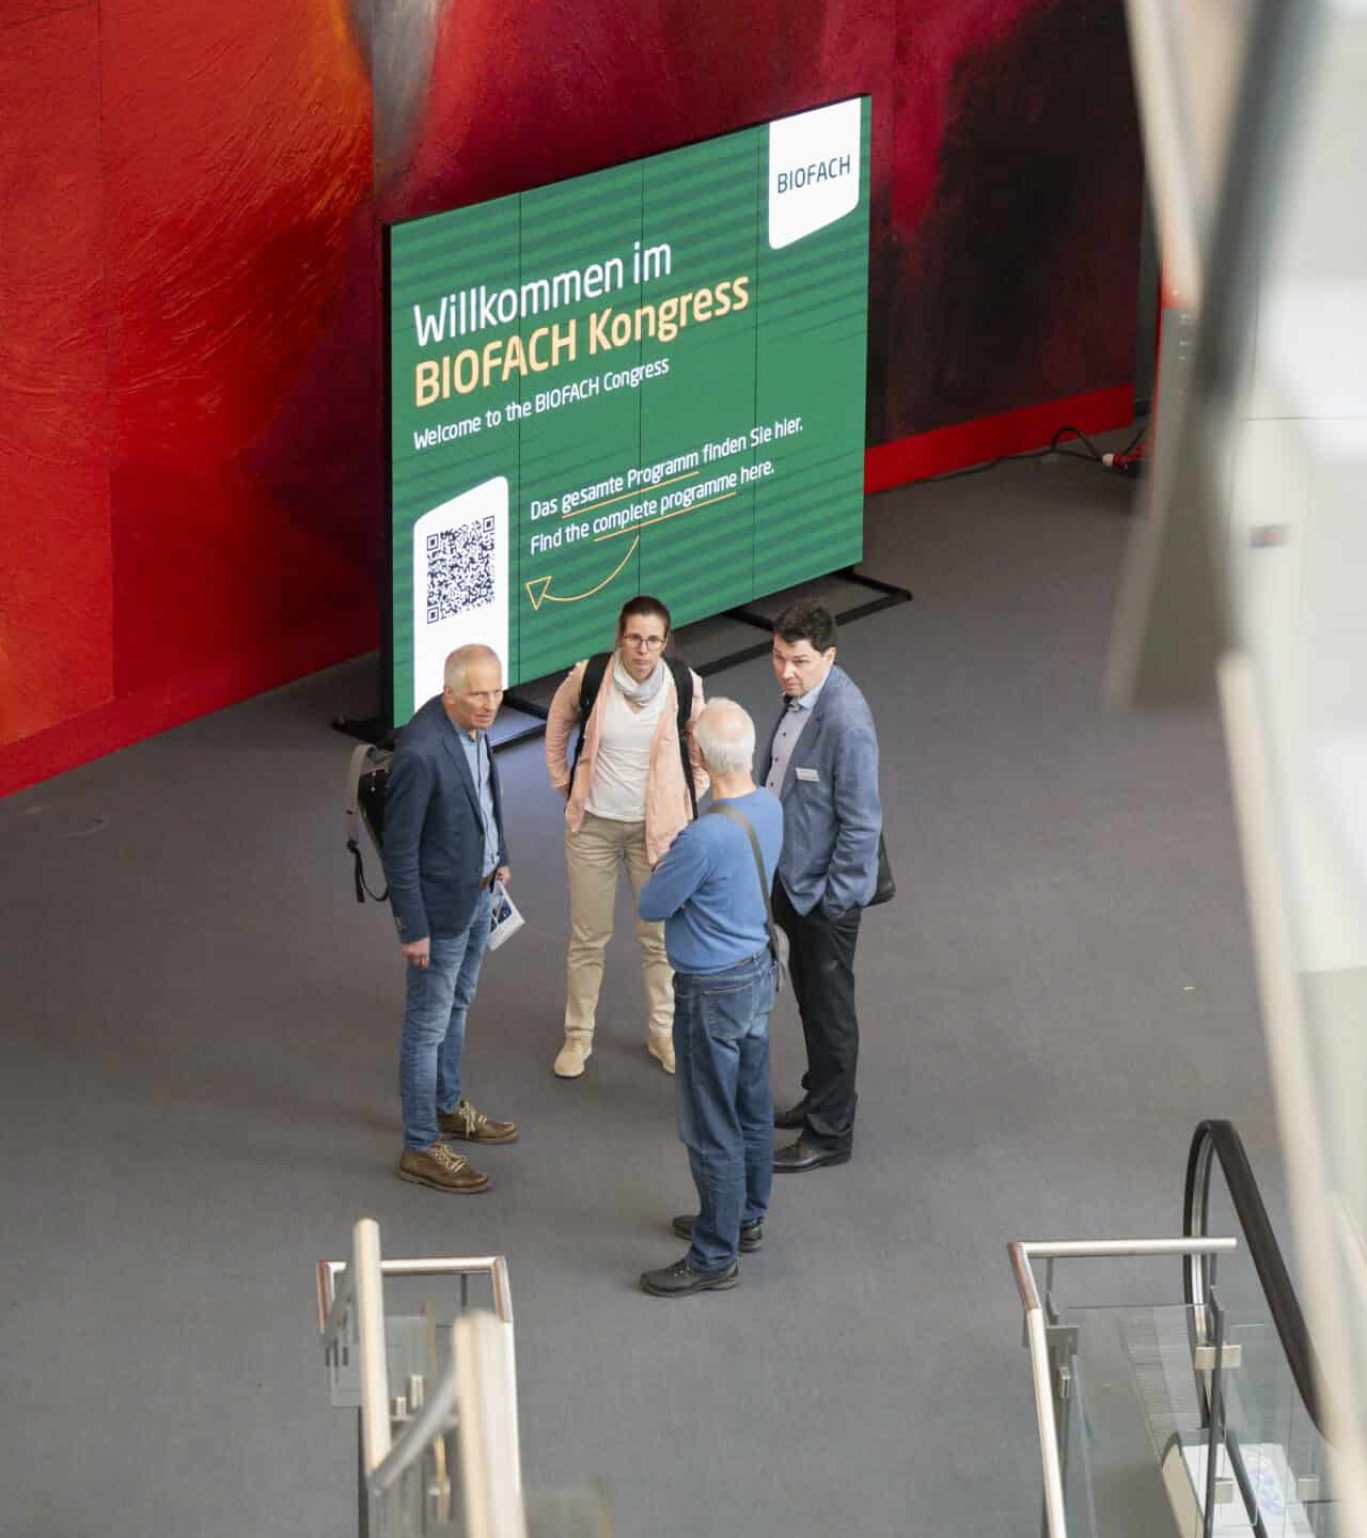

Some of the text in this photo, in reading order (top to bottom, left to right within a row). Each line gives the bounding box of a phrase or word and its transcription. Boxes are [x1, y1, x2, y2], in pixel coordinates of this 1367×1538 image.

[777, 154, 851, 194] BIOFACH
[413, 241, 672, 347] Willkommen im
[415, 276, 750, 407] BIOFACH Kongress
[413, 358, 670, 450] Welcome to the BIOFACH Congress
[531, 416, 803, 520] Das gesamte Programm finden Sie hier.
[531, 460, 775, 555] Find the complete programme here.
